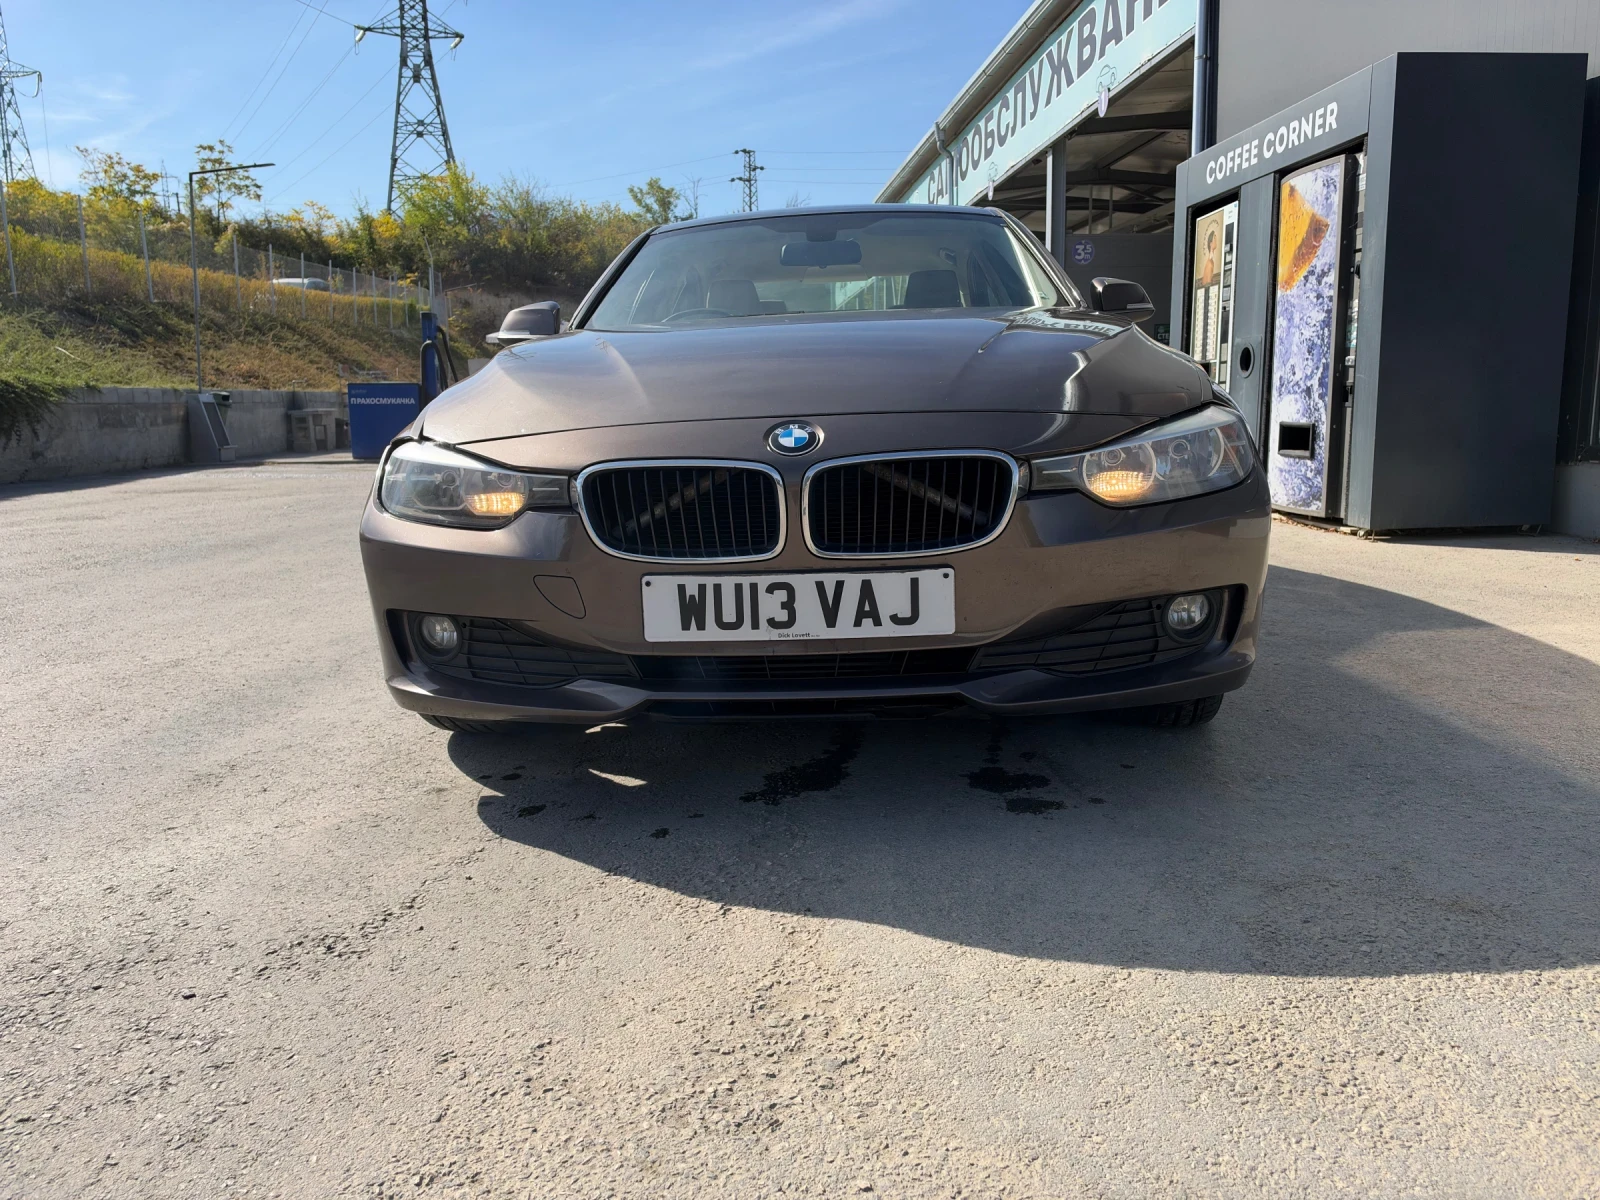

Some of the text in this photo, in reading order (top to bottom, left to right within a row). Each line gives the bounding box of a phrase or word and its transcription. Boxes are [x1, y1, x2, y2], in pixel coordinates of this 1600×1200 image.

[1206, 101, 1338, 185] COFFEE CORNER
[350, 397, 415, 405] ПРАХОСМУКАЧКА
[775, 424, 813, 435] BMW
[677, 577, 920, 632] WU13 VAJ
